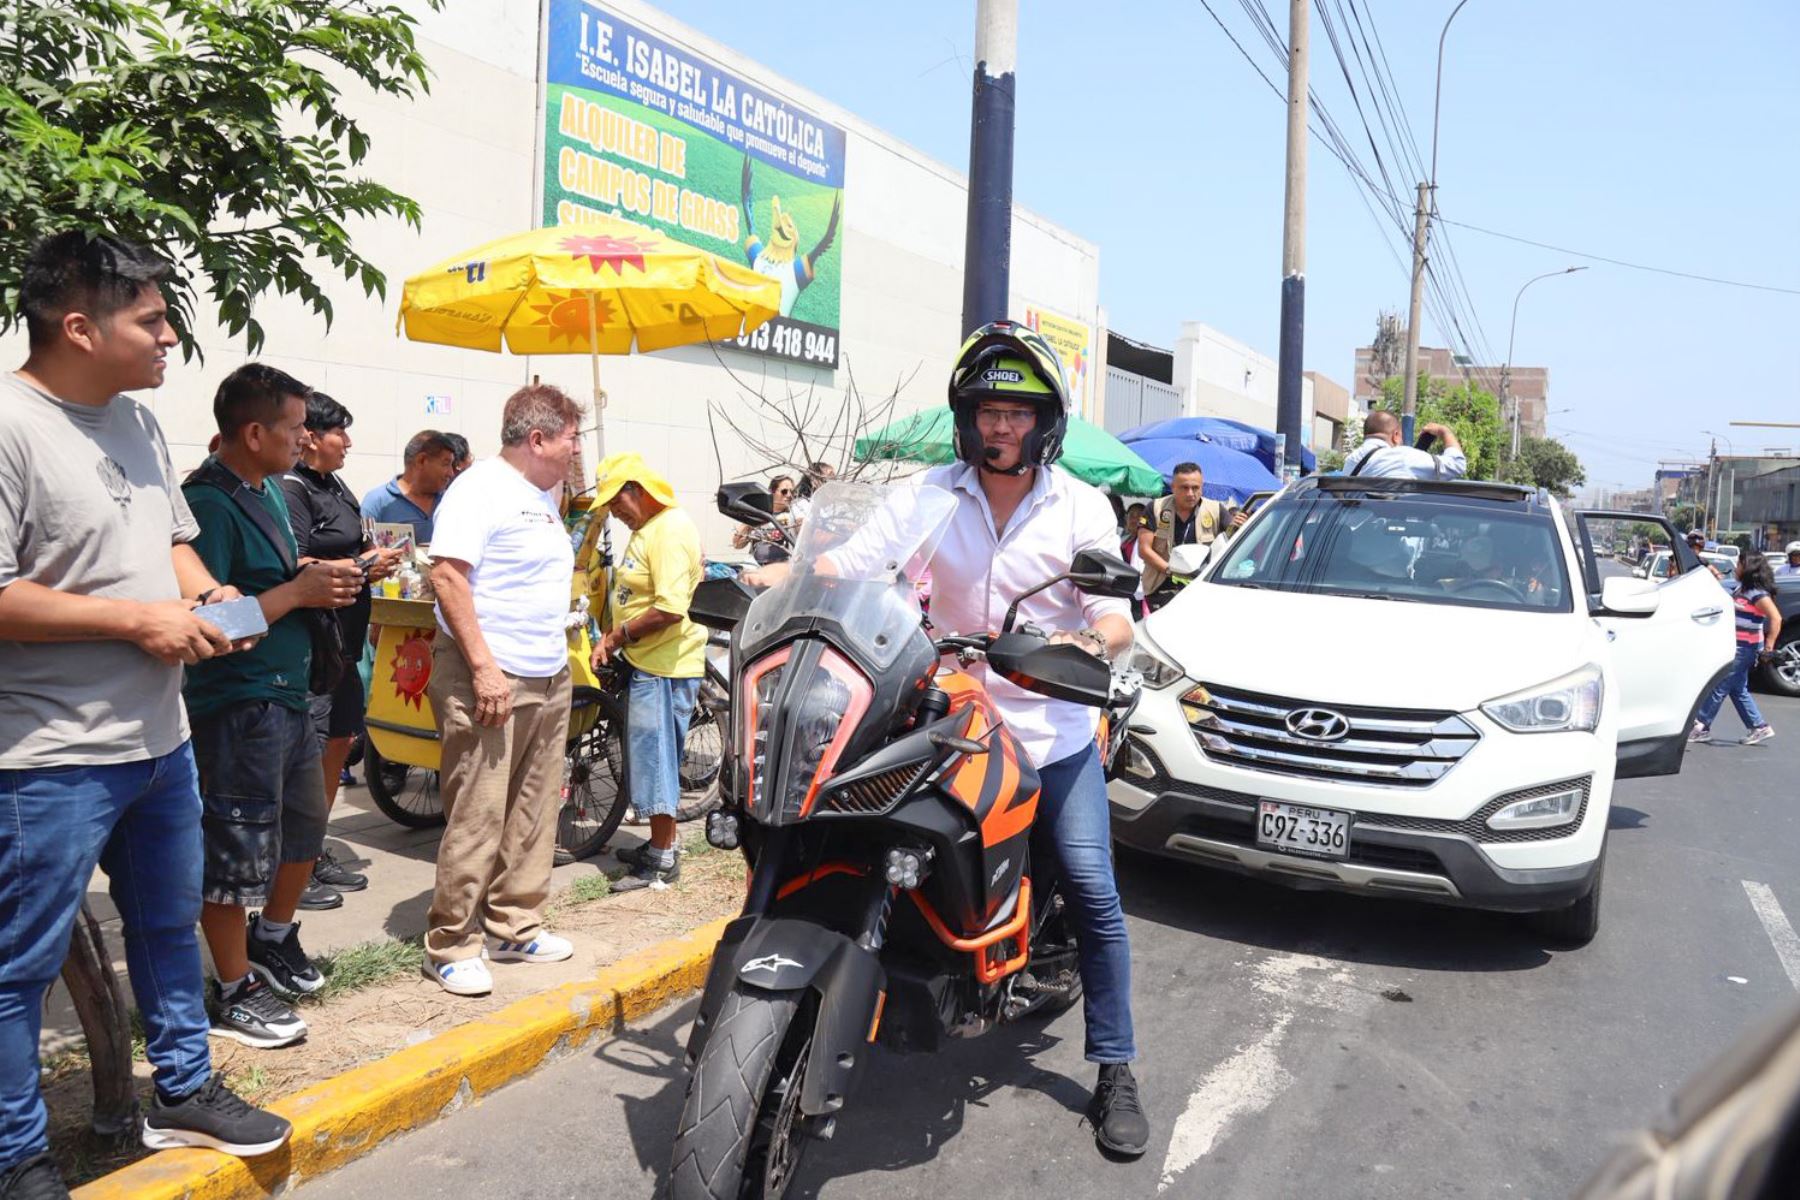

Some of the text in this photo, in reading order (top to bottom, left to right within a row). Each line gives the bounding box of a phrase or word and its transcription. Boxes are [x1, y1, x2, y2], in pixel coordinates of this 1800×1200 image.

[580, 12, 825, 160] I.E. ISABEL LA CATÓLICA
[559, 91, 687, 179] ALQUILER DE
[630, 79, 668, 110] segura
[668, 97, 676, 117] y
[678, 102, 725, 136] saludable
[726, 123, 744, 144] que
[745, 132, 787, 162] promueve
[788, 147, 797, 166] el
[559, 147, 652, 216] CAMPOS
[650, 178, 680, 227] DE
[679, 187, 740, 244] GRASS
[772, 324, 802, 358] 418
[804, 331, 835, 364] 944
[986, 370, 1019, 382] SHOEI
[1261, 813, 1344, 849] C9Z-336
[1288, 806, 1320, 820] PERU
